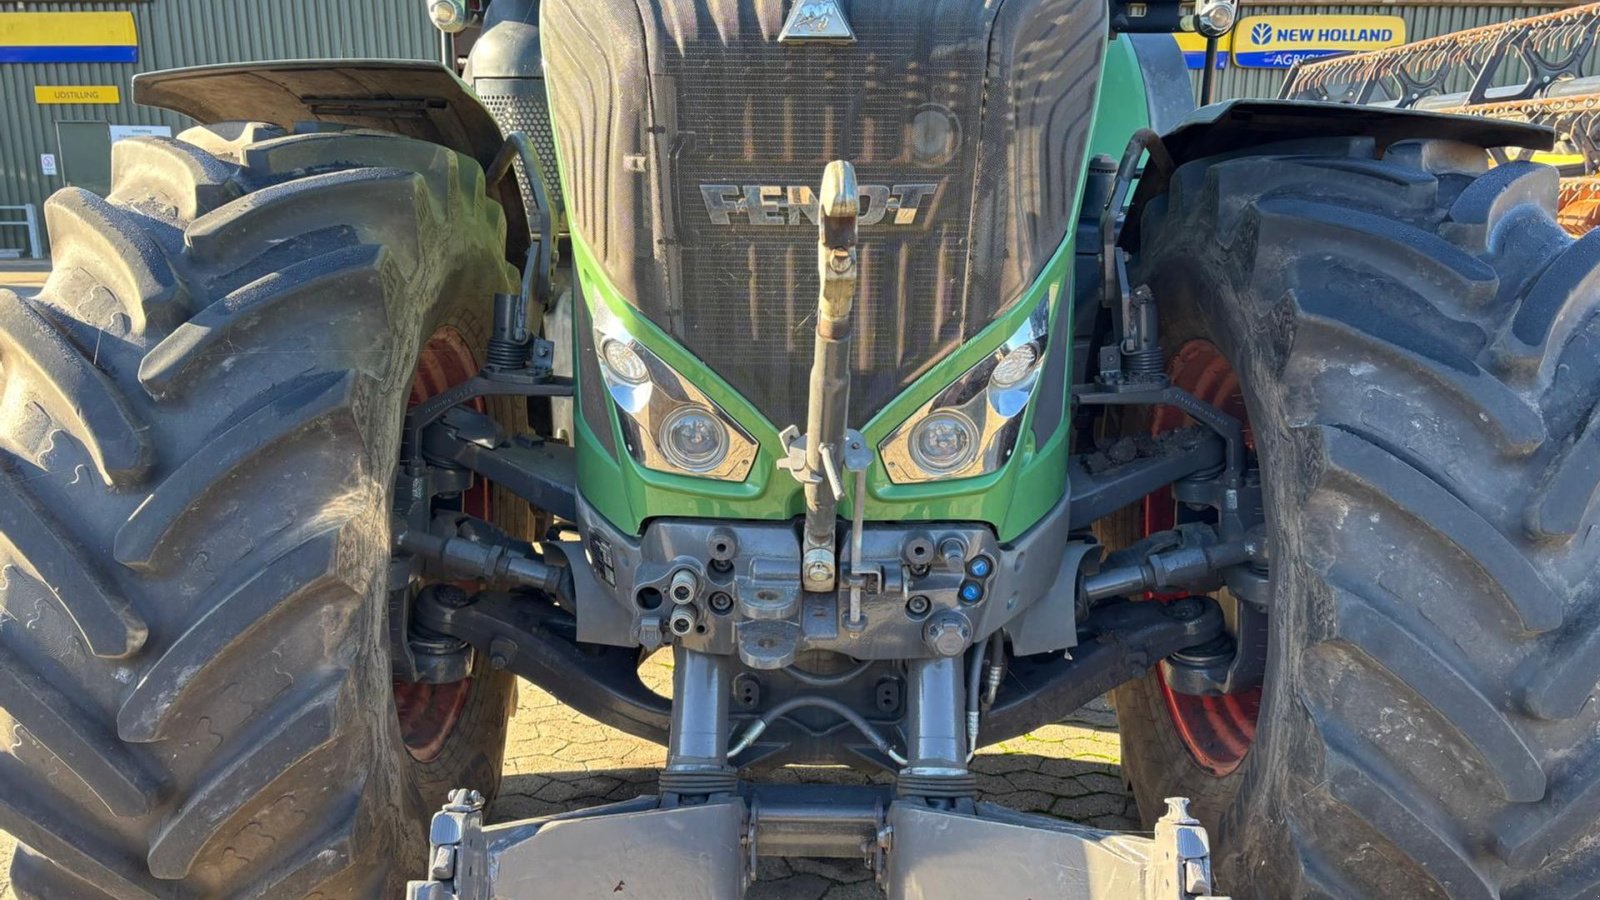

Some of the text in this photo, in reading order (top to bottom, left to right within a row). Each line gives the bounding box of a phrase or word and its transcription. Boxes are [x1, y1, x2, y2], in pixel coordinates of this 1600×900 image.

[1276, 28, 1393, 42] NEW HOLLAND
[54, 90, 99, 99] UDSTILLING
[699, 183, 938, 226] FENDT
